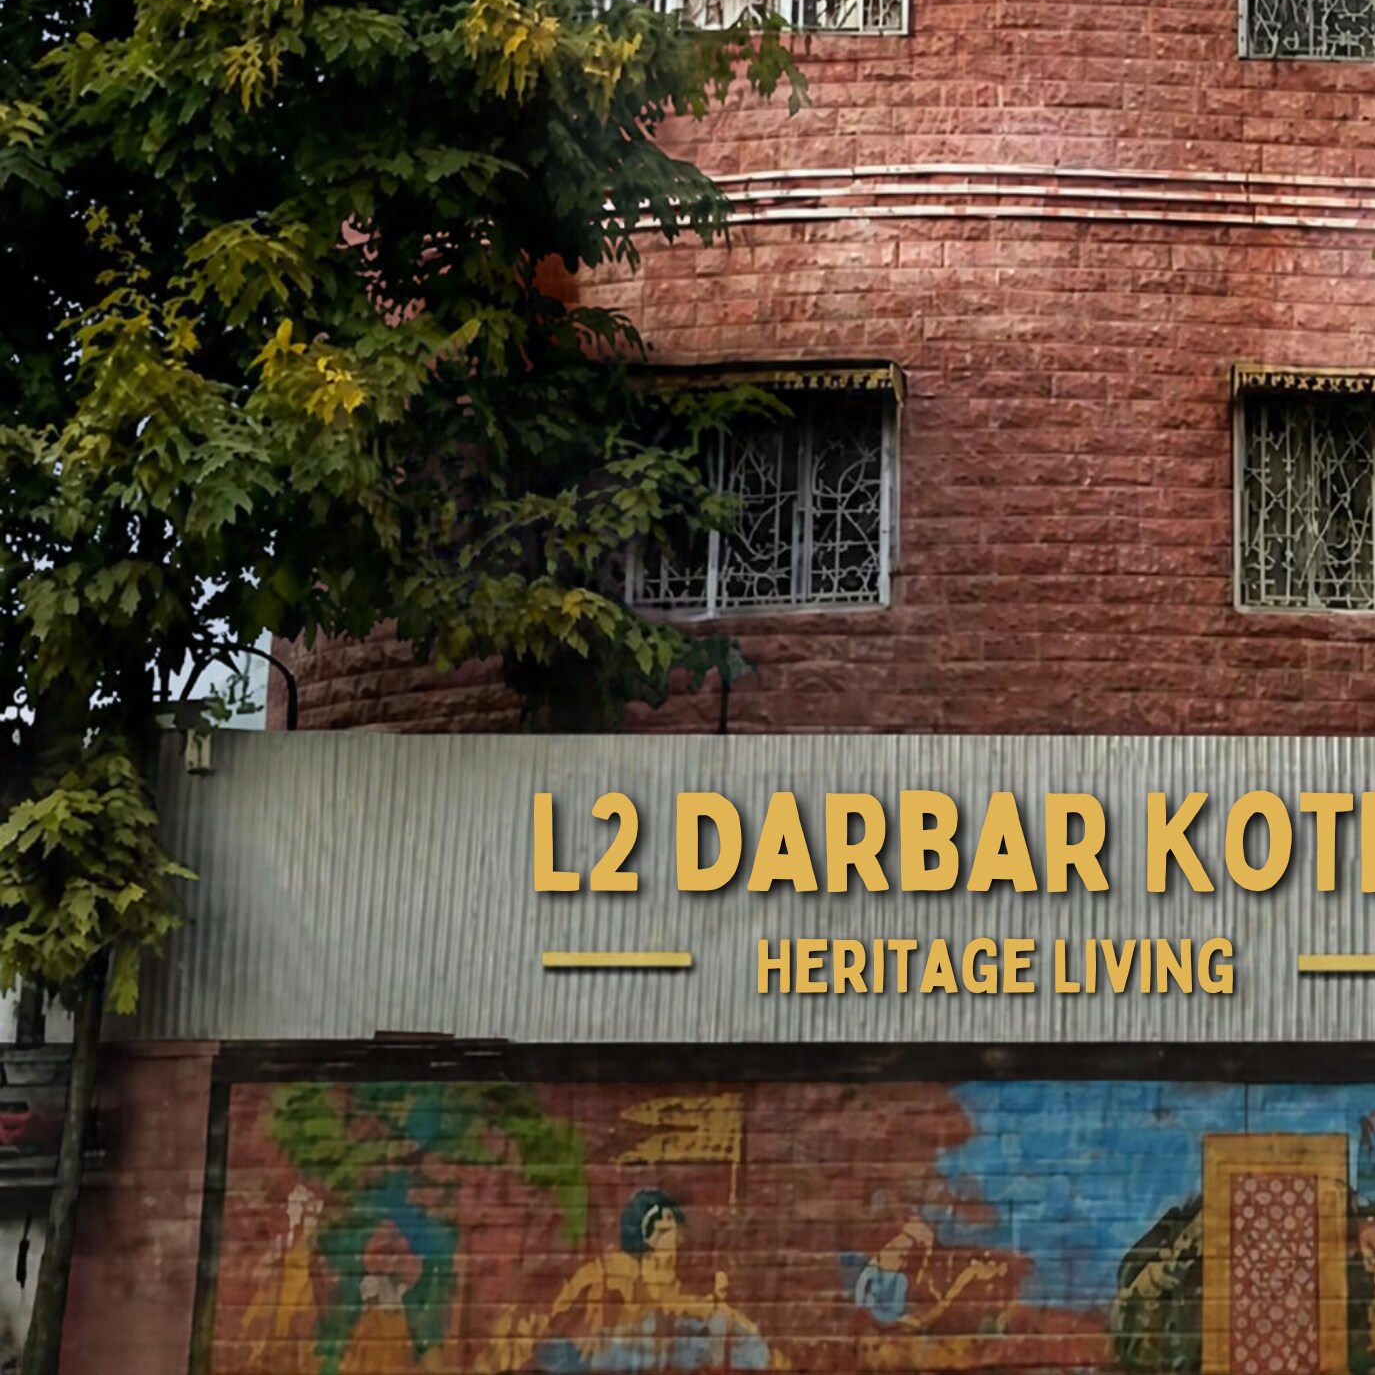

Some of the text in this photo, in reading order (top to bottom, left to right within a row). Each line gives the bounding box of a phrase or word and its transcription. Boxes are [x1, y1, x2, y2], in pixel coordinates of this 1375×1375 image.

[533, 791, 638, 892] L2
[676, 790, 1109, 893] DARBAR
[757, 937, 1233, 994] HERITAGE LIVING
